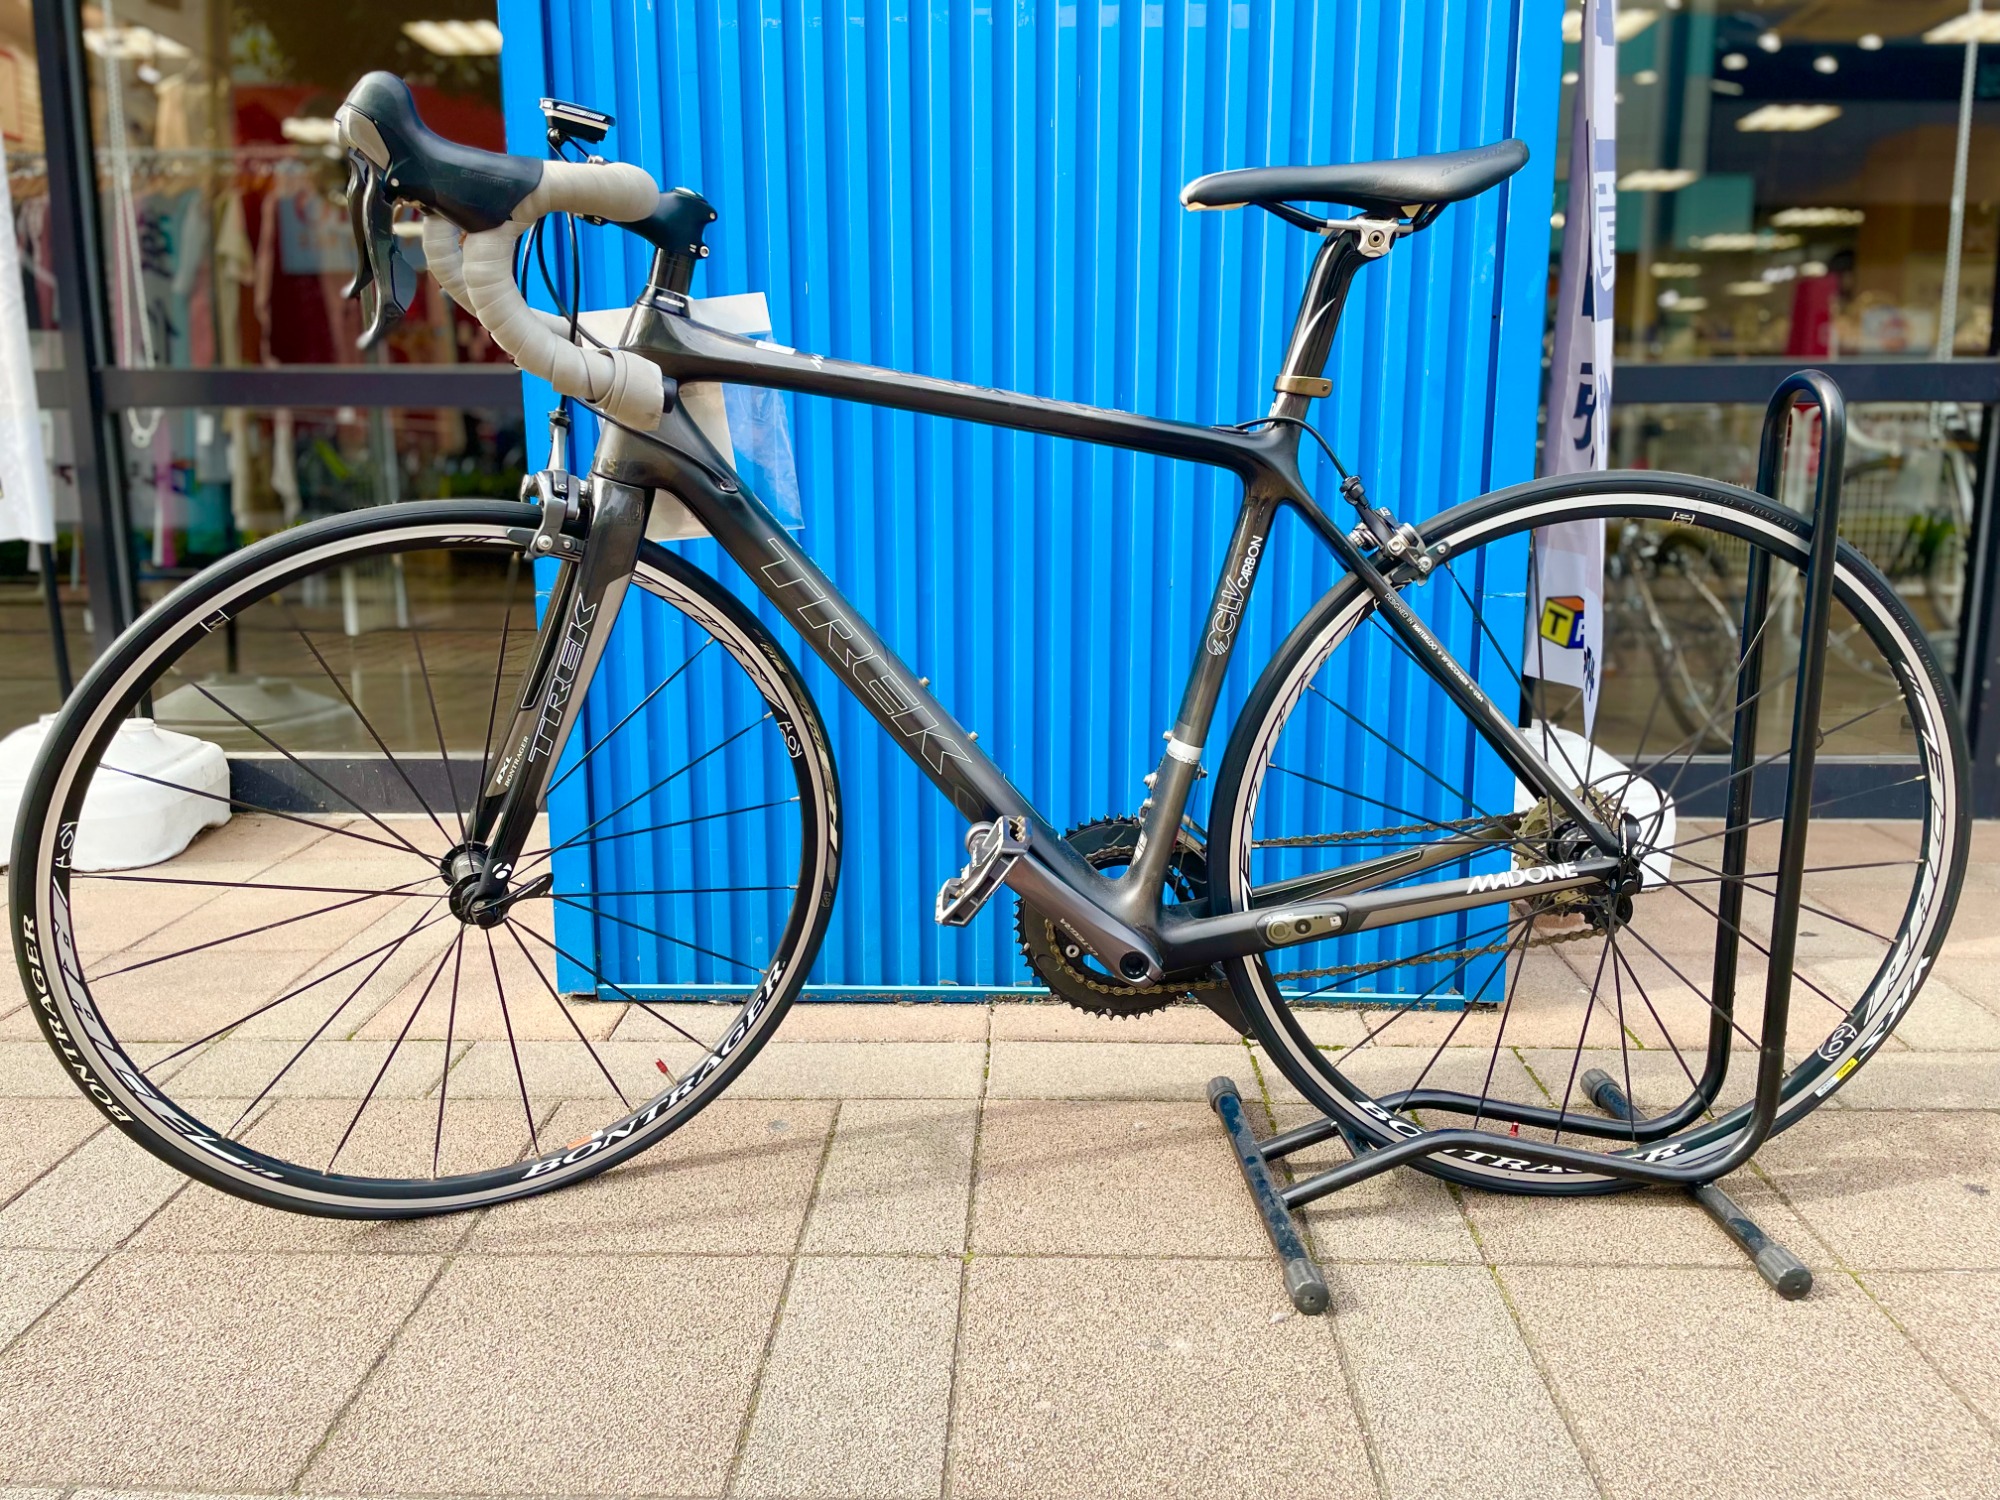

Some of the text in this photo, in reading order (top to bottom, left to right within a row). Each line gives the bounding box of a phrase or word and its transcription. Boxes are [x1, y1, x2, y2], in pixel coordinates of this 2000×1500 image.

[1237, 535, 1263, 589] CARBON
[528, 592, 597, 763] TREK
[761, 537, 973, 775] TREK
[1384, 592, 1409, 618] DESIGNED
[1412, 623, 1438, 651] WATERLOO
[1473, 689, 1484, 702] USA
[496, 755, 513, 785] RXL
[505, 735, 530, 788] BONTRAGER
[1466, 862, 1579, 895] MADONE
[23, 914, 135, 1122] BONTRAGER
[521, 960, 785, 1180] BONTRAGER
